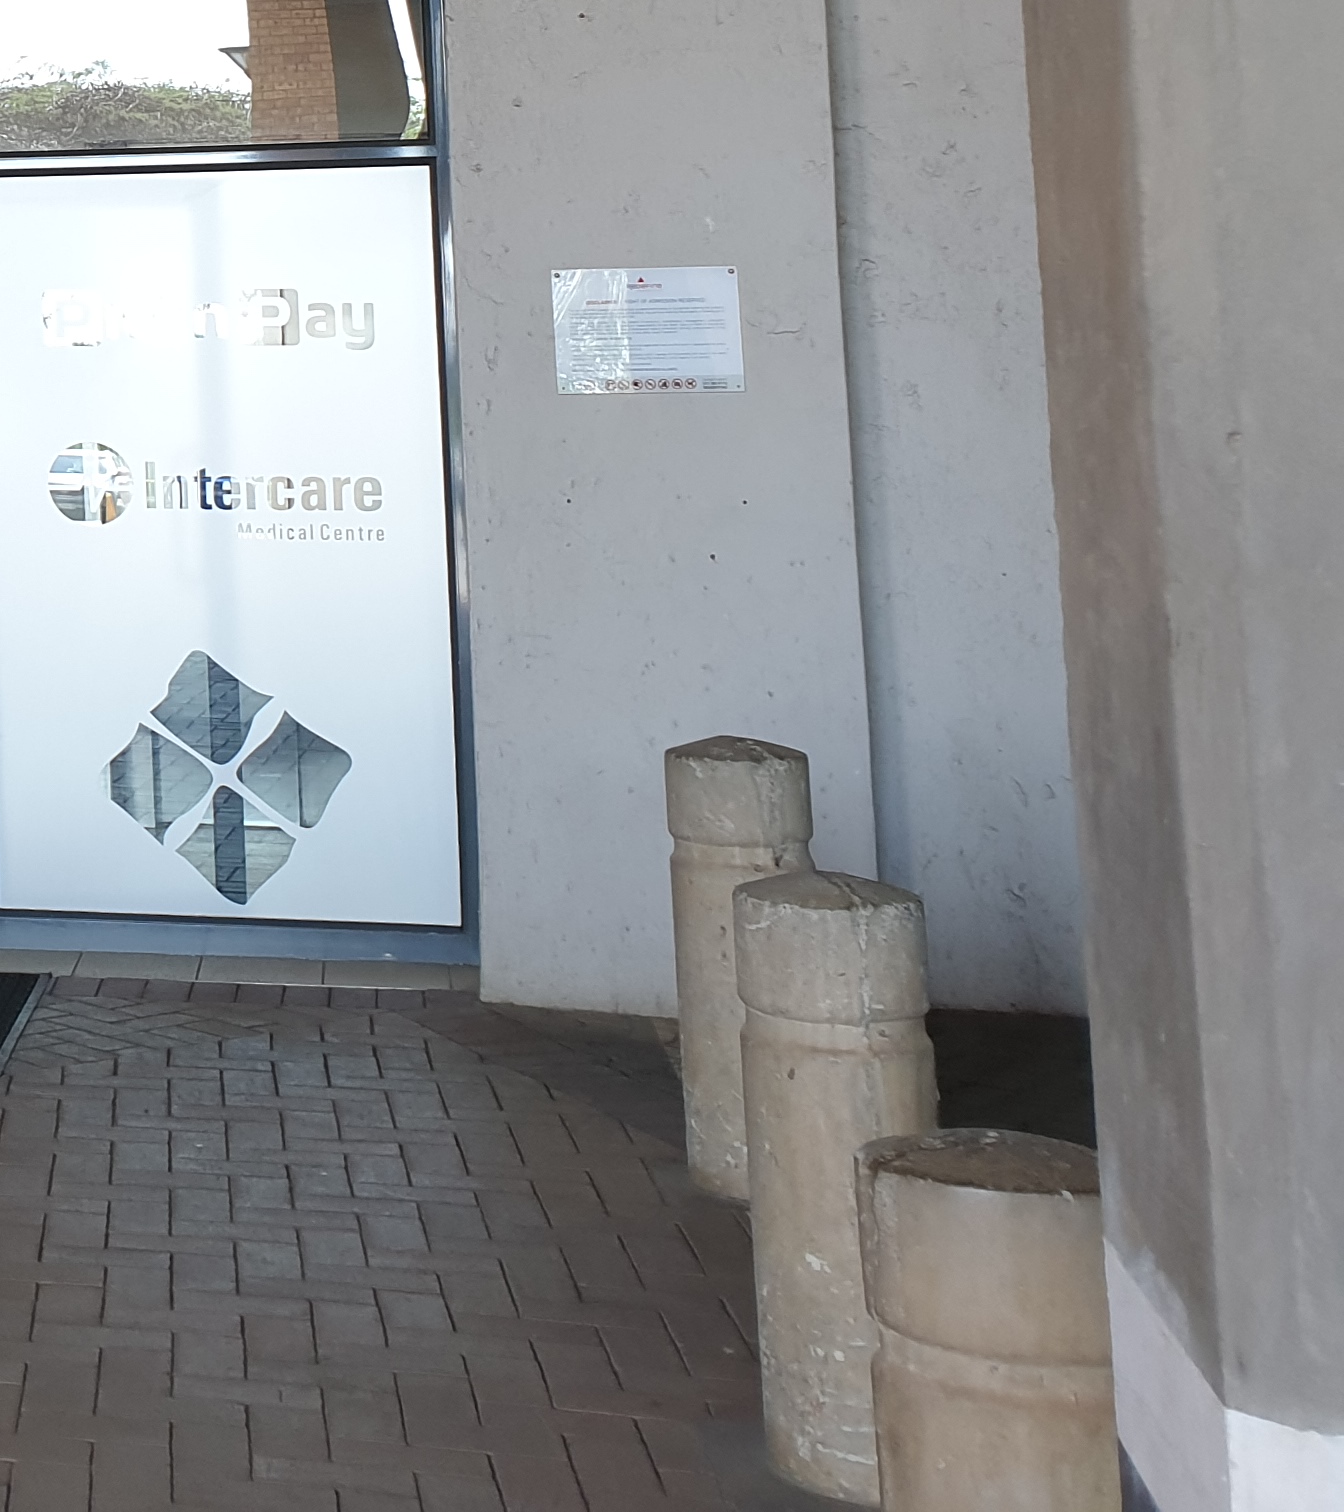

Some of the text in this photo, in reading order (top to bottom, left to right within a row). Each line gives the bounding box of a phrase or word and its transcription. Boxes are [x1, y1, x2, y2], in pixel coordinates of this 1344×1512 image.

[144, 460, 384, 513] Intercare
[237, 522, 386, 541] Medical Centre
